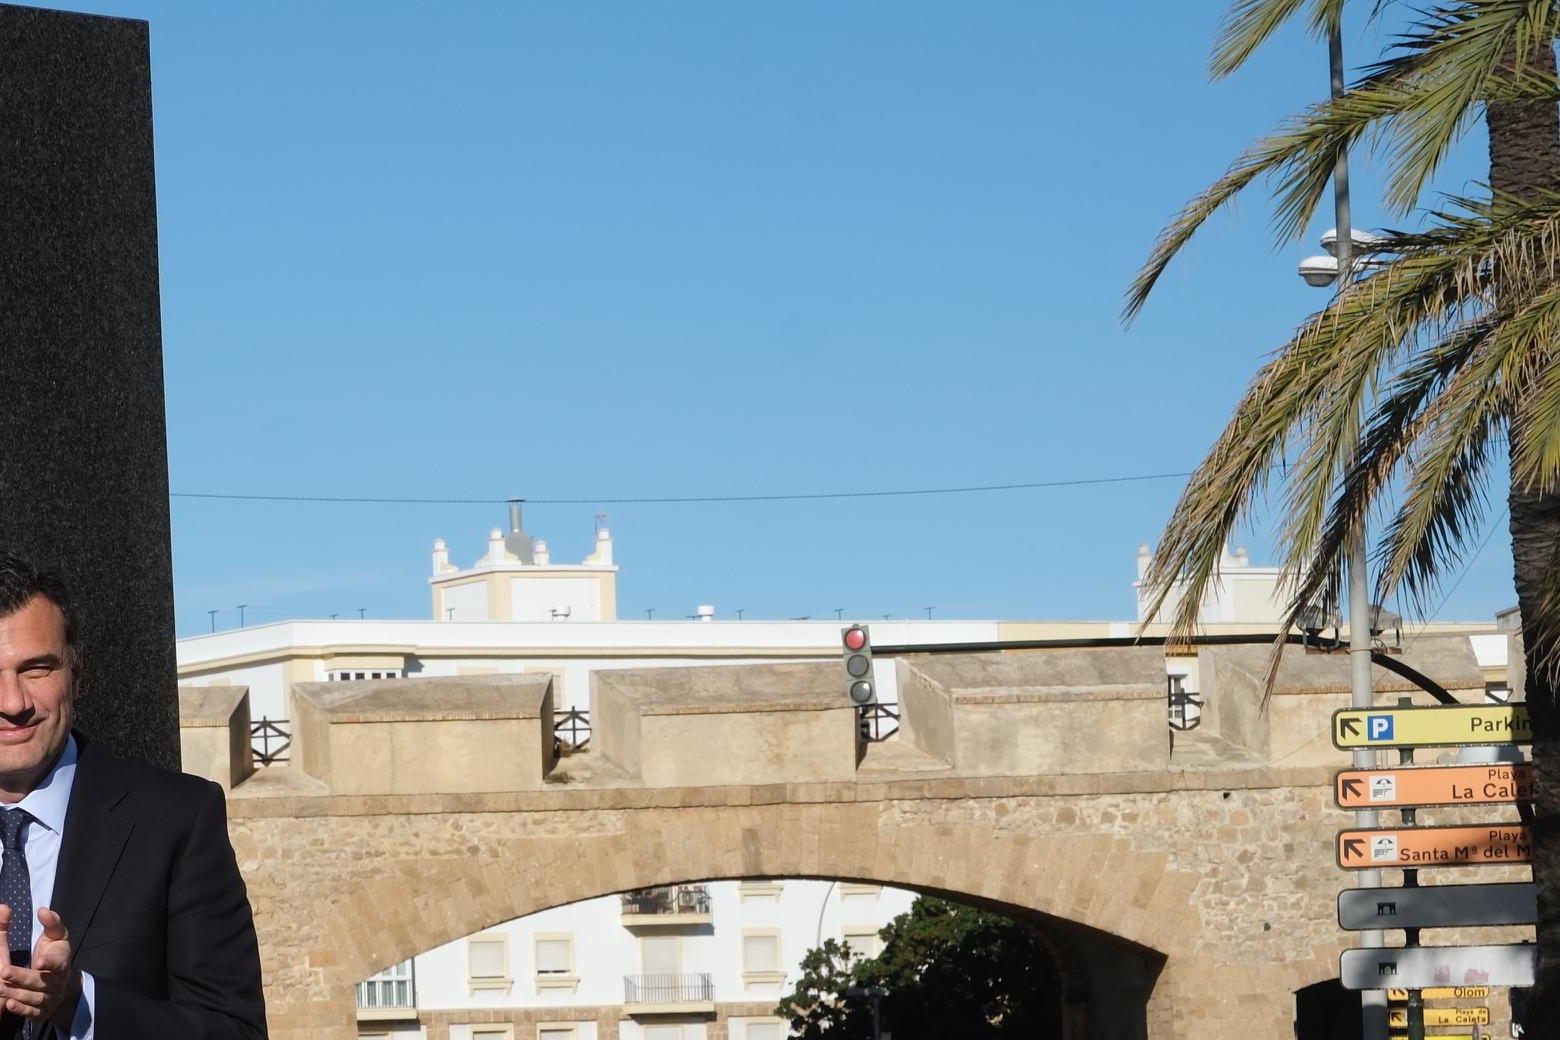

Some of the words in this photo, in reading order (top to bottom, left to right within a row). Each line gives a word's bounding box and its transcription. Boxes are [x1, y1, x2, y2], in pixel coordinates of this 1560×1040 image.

[1372, 718, 1389, 738] P
[1471, 715, 1533, 732] Parkin
[1488, 769, 1526, 781] Playa
[1452, 784, 1474, 800] La
[1489, 830, 1527, 843] Playa
[1400, 848, 1449, 862] Santa
[1483, 845, 1509, 858] del
[1438, 1016, 1449, 1024] La
[1456, 1015, 1487, 1024] Caleta
